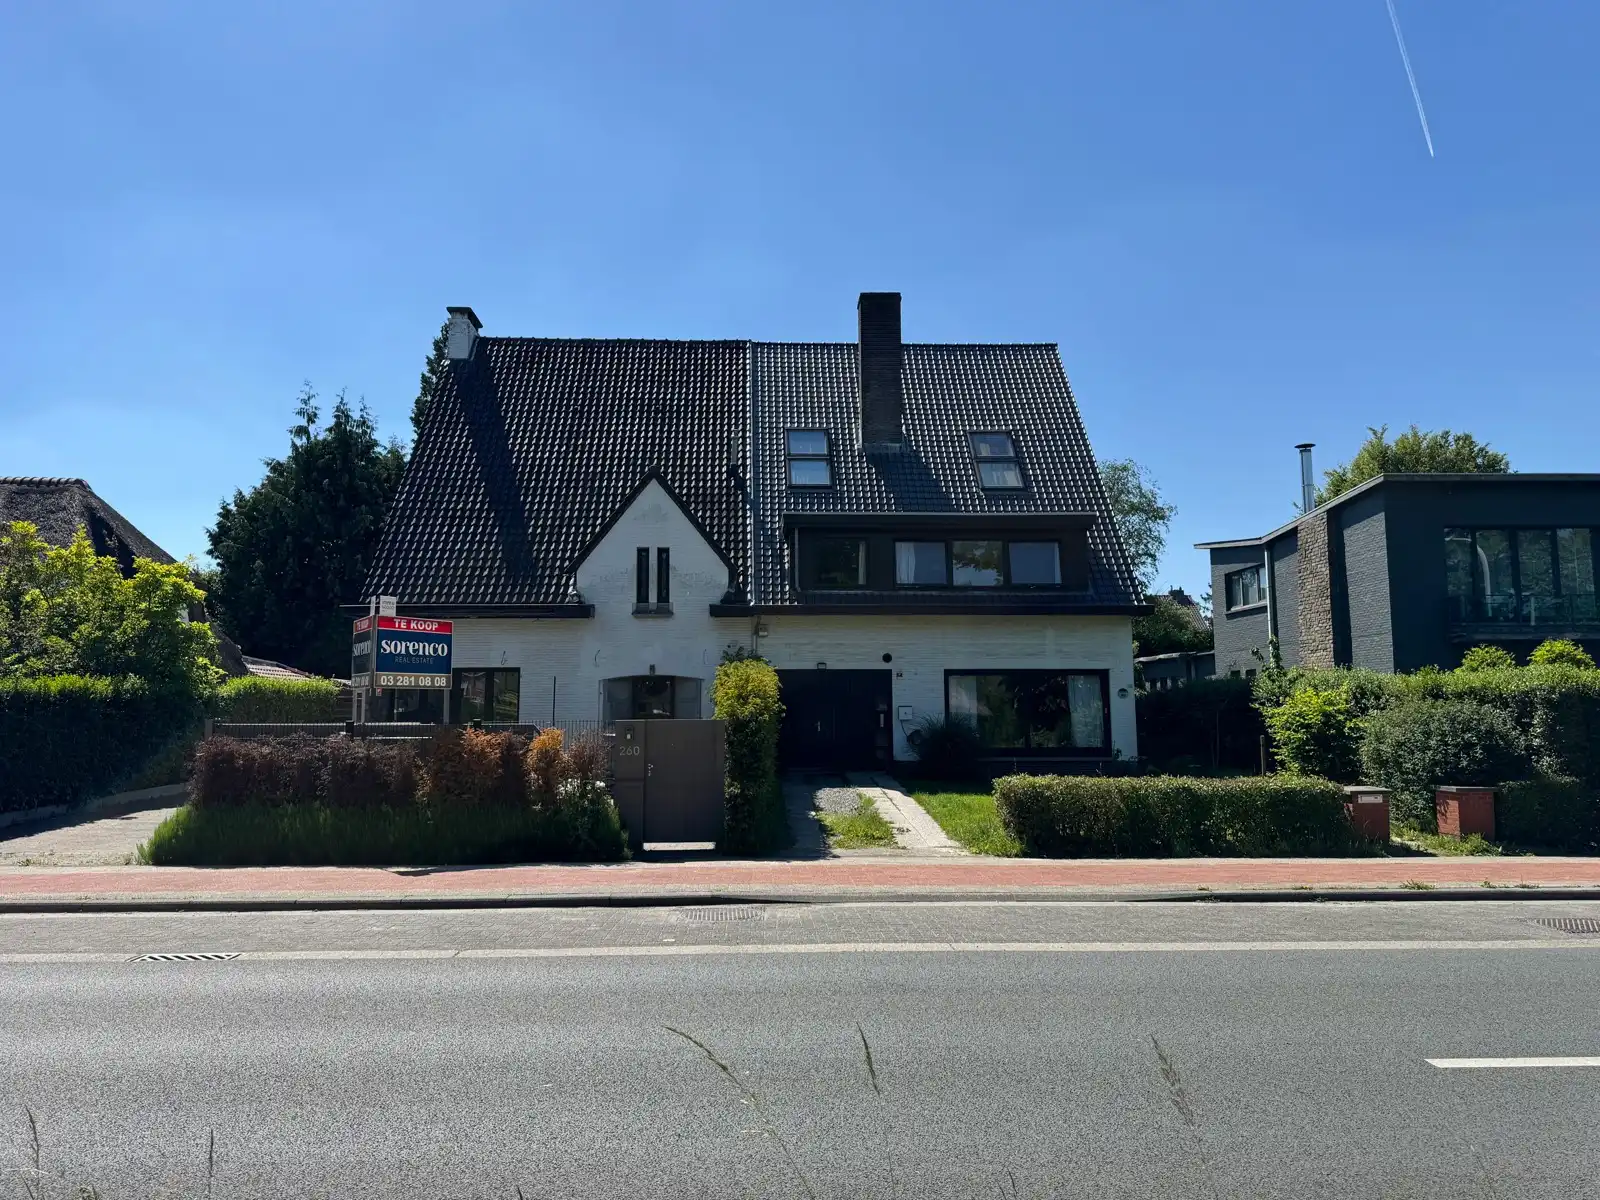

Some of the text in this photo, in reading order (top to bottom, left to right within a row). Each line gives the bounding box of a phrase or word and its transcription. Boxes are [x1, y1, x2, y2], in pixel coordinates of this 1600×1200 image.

[394, 618, 438, 630] TE KOOP
[380, 640, 448, 656] sorenco
[380, 676, 394, 686] 03
[396, 676, 415, 686] 281
[418, 676, 432, 686] 08
[434, 676, 446, 686] 08
[620, 746, 640, 756] 260
